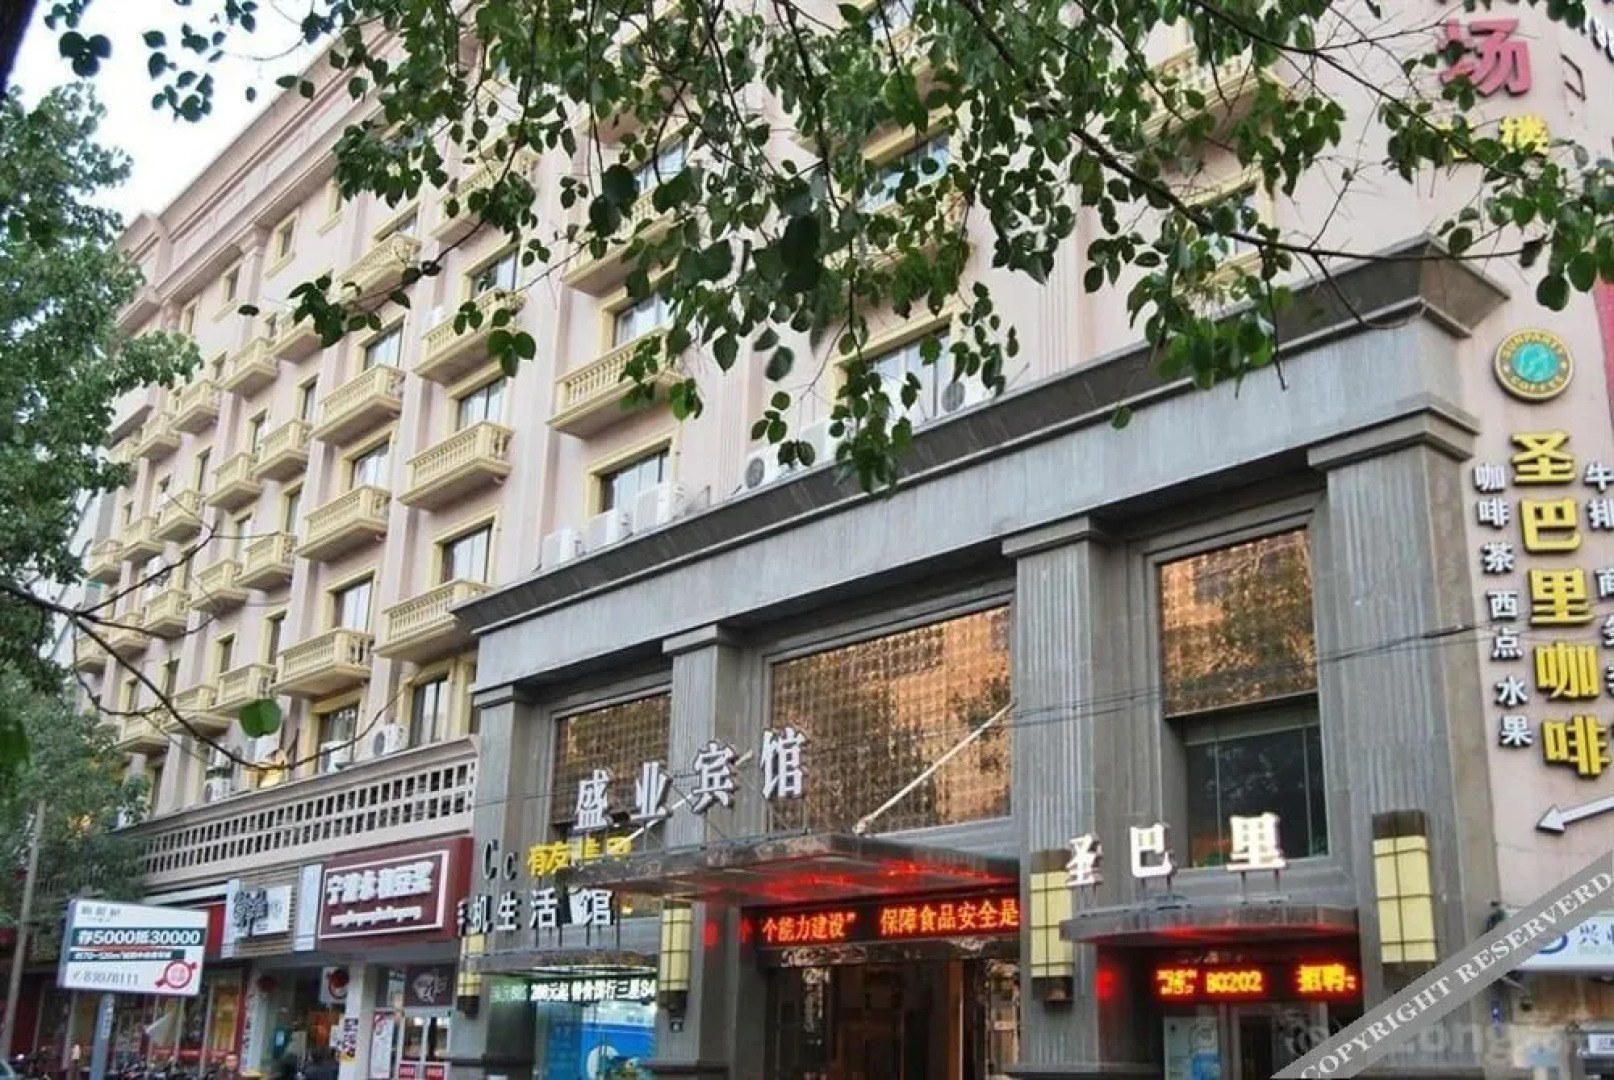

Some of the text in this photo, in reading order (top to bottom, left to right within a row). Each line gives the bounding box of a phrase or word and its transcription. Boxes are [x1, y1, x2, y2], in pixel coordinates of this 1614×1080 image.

[1511, 430, 1611, 778] 圣巴里咖啡
[572, 727, 806, 831] 盛业宾馆
[1065, 811, 1288, 887] 圣巴里
